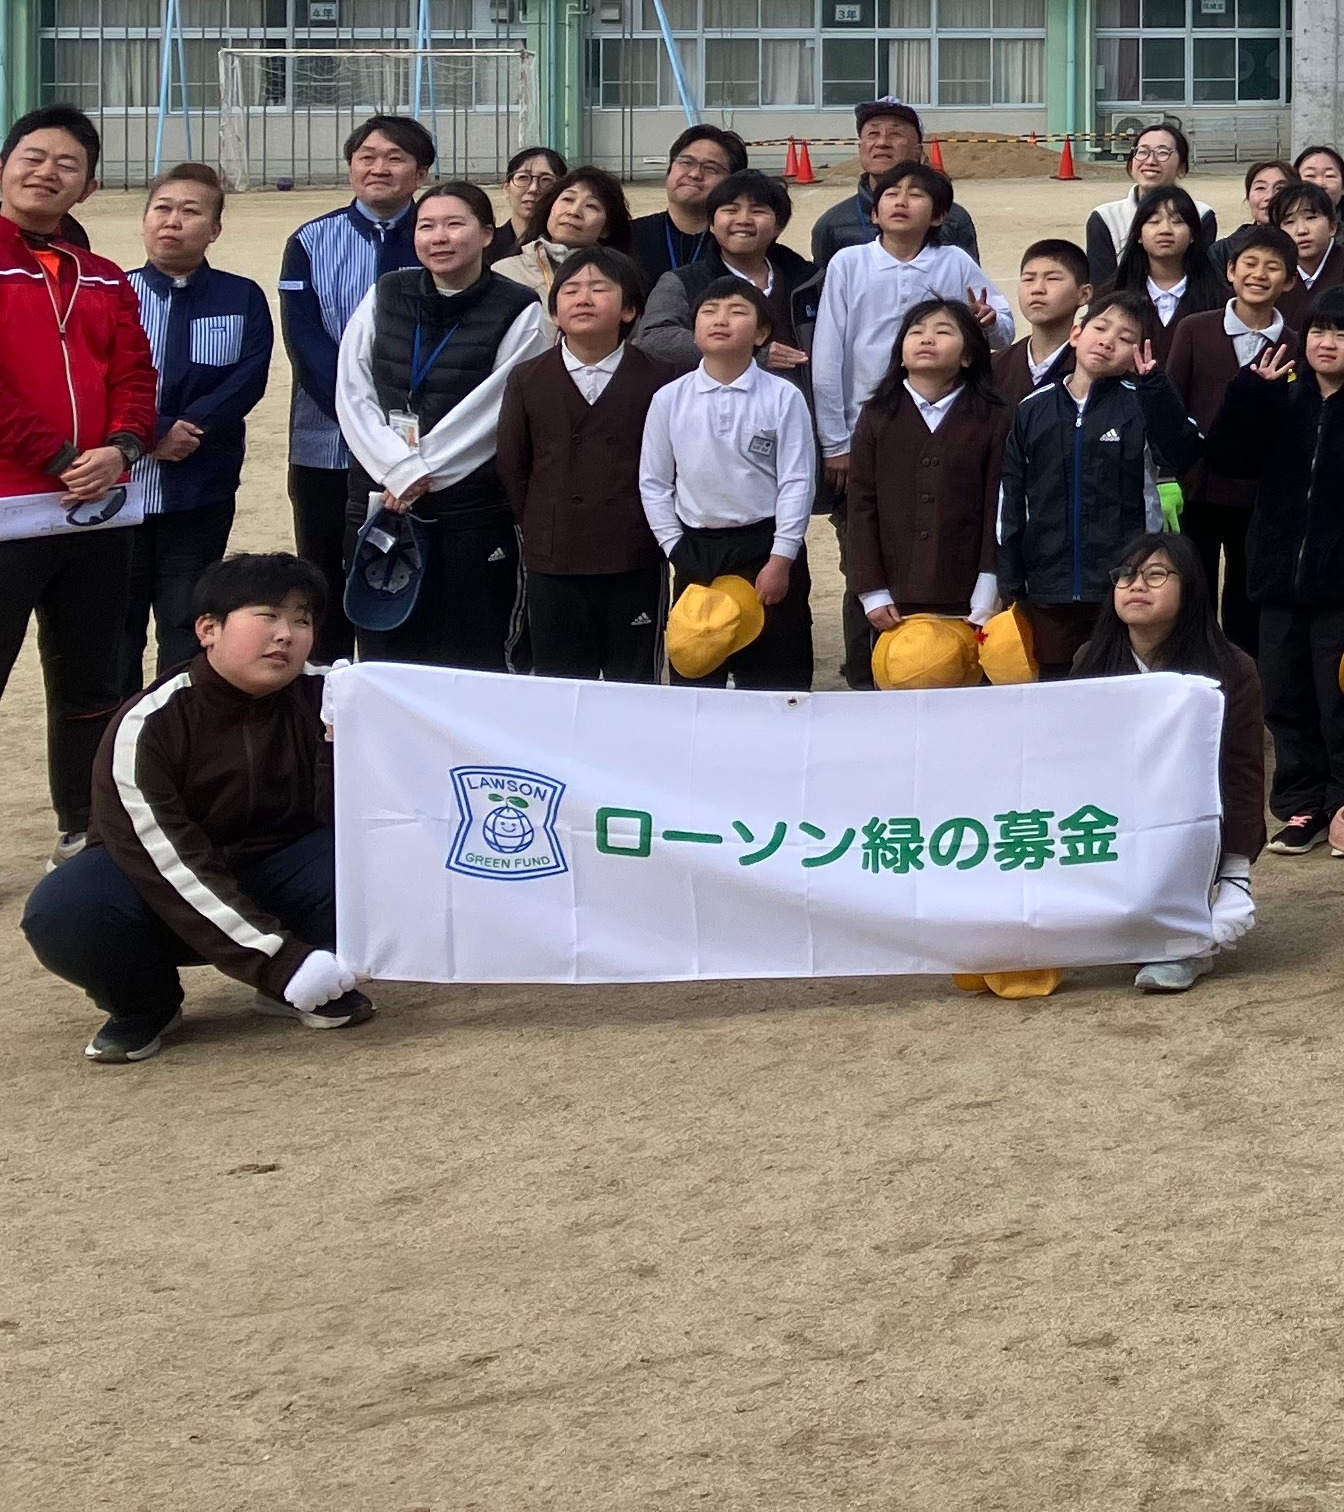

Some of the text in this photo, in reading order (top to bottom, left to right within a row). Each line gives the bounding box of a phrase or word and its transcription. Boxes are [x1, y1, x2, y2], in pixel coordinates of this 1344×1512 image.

[312, 7, 335, 19] 4年
[838, 9, 857, 21] 3年
[466, 777, 548, 802] LAWSON
[595, 803, 1119, 875] ローソン緑の募金
[465, 852, 551, 869] GREEN FUND
